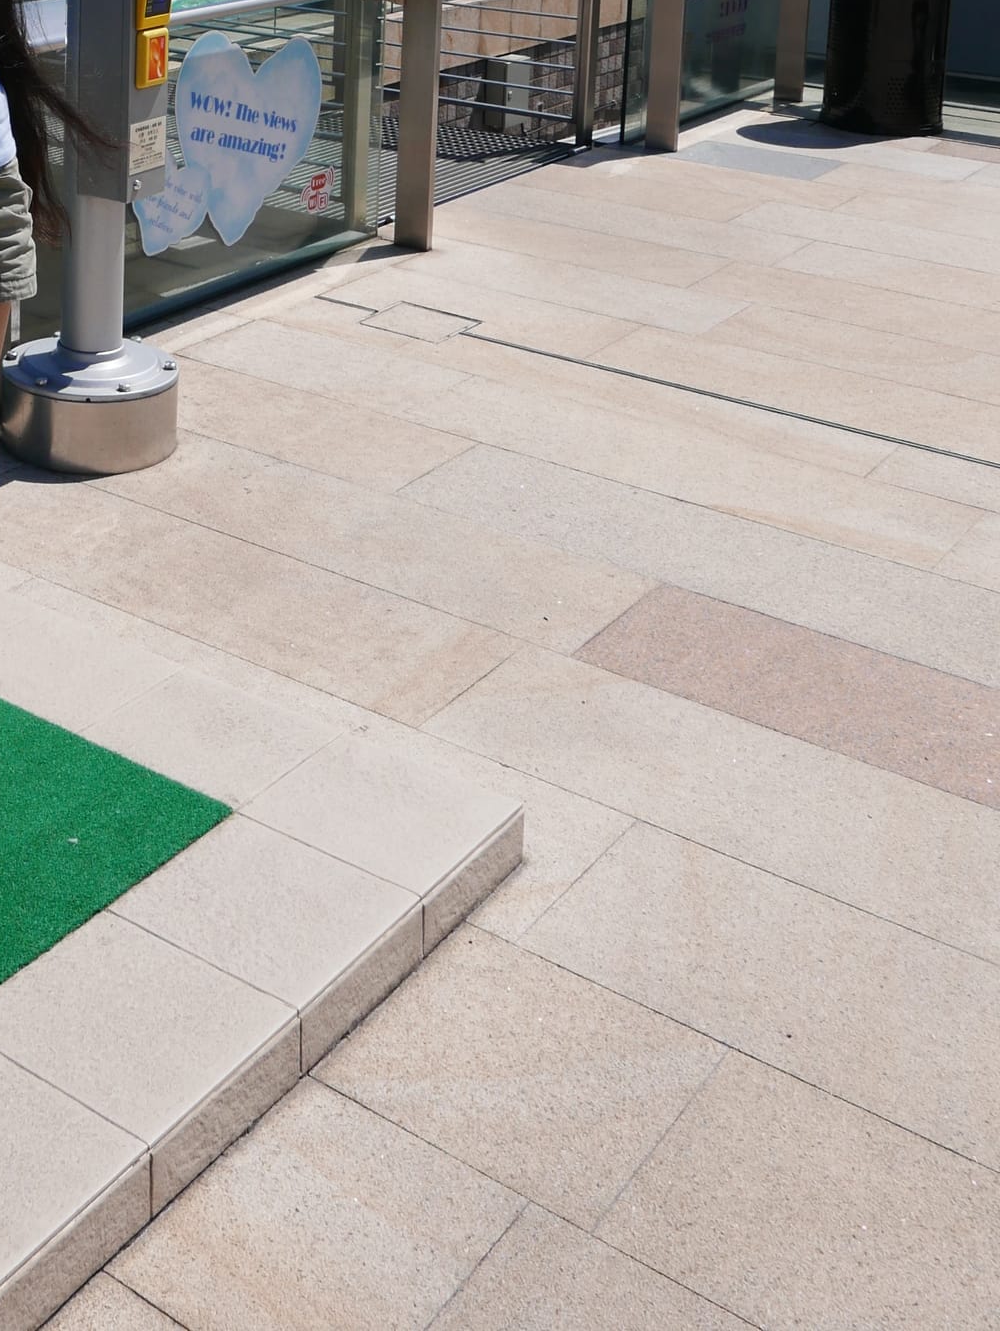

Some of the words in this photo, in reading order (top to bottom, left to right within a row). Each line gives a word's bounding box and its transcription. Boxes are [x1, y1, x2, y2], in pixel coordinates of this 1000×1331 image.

[190, 91, 232, 117] WOW!
[236, 102, 259, 124] The
[263, 110, 297, 133] views
[190, 127, 215, 144] are
[218, 133, 287, 163] amazing!
